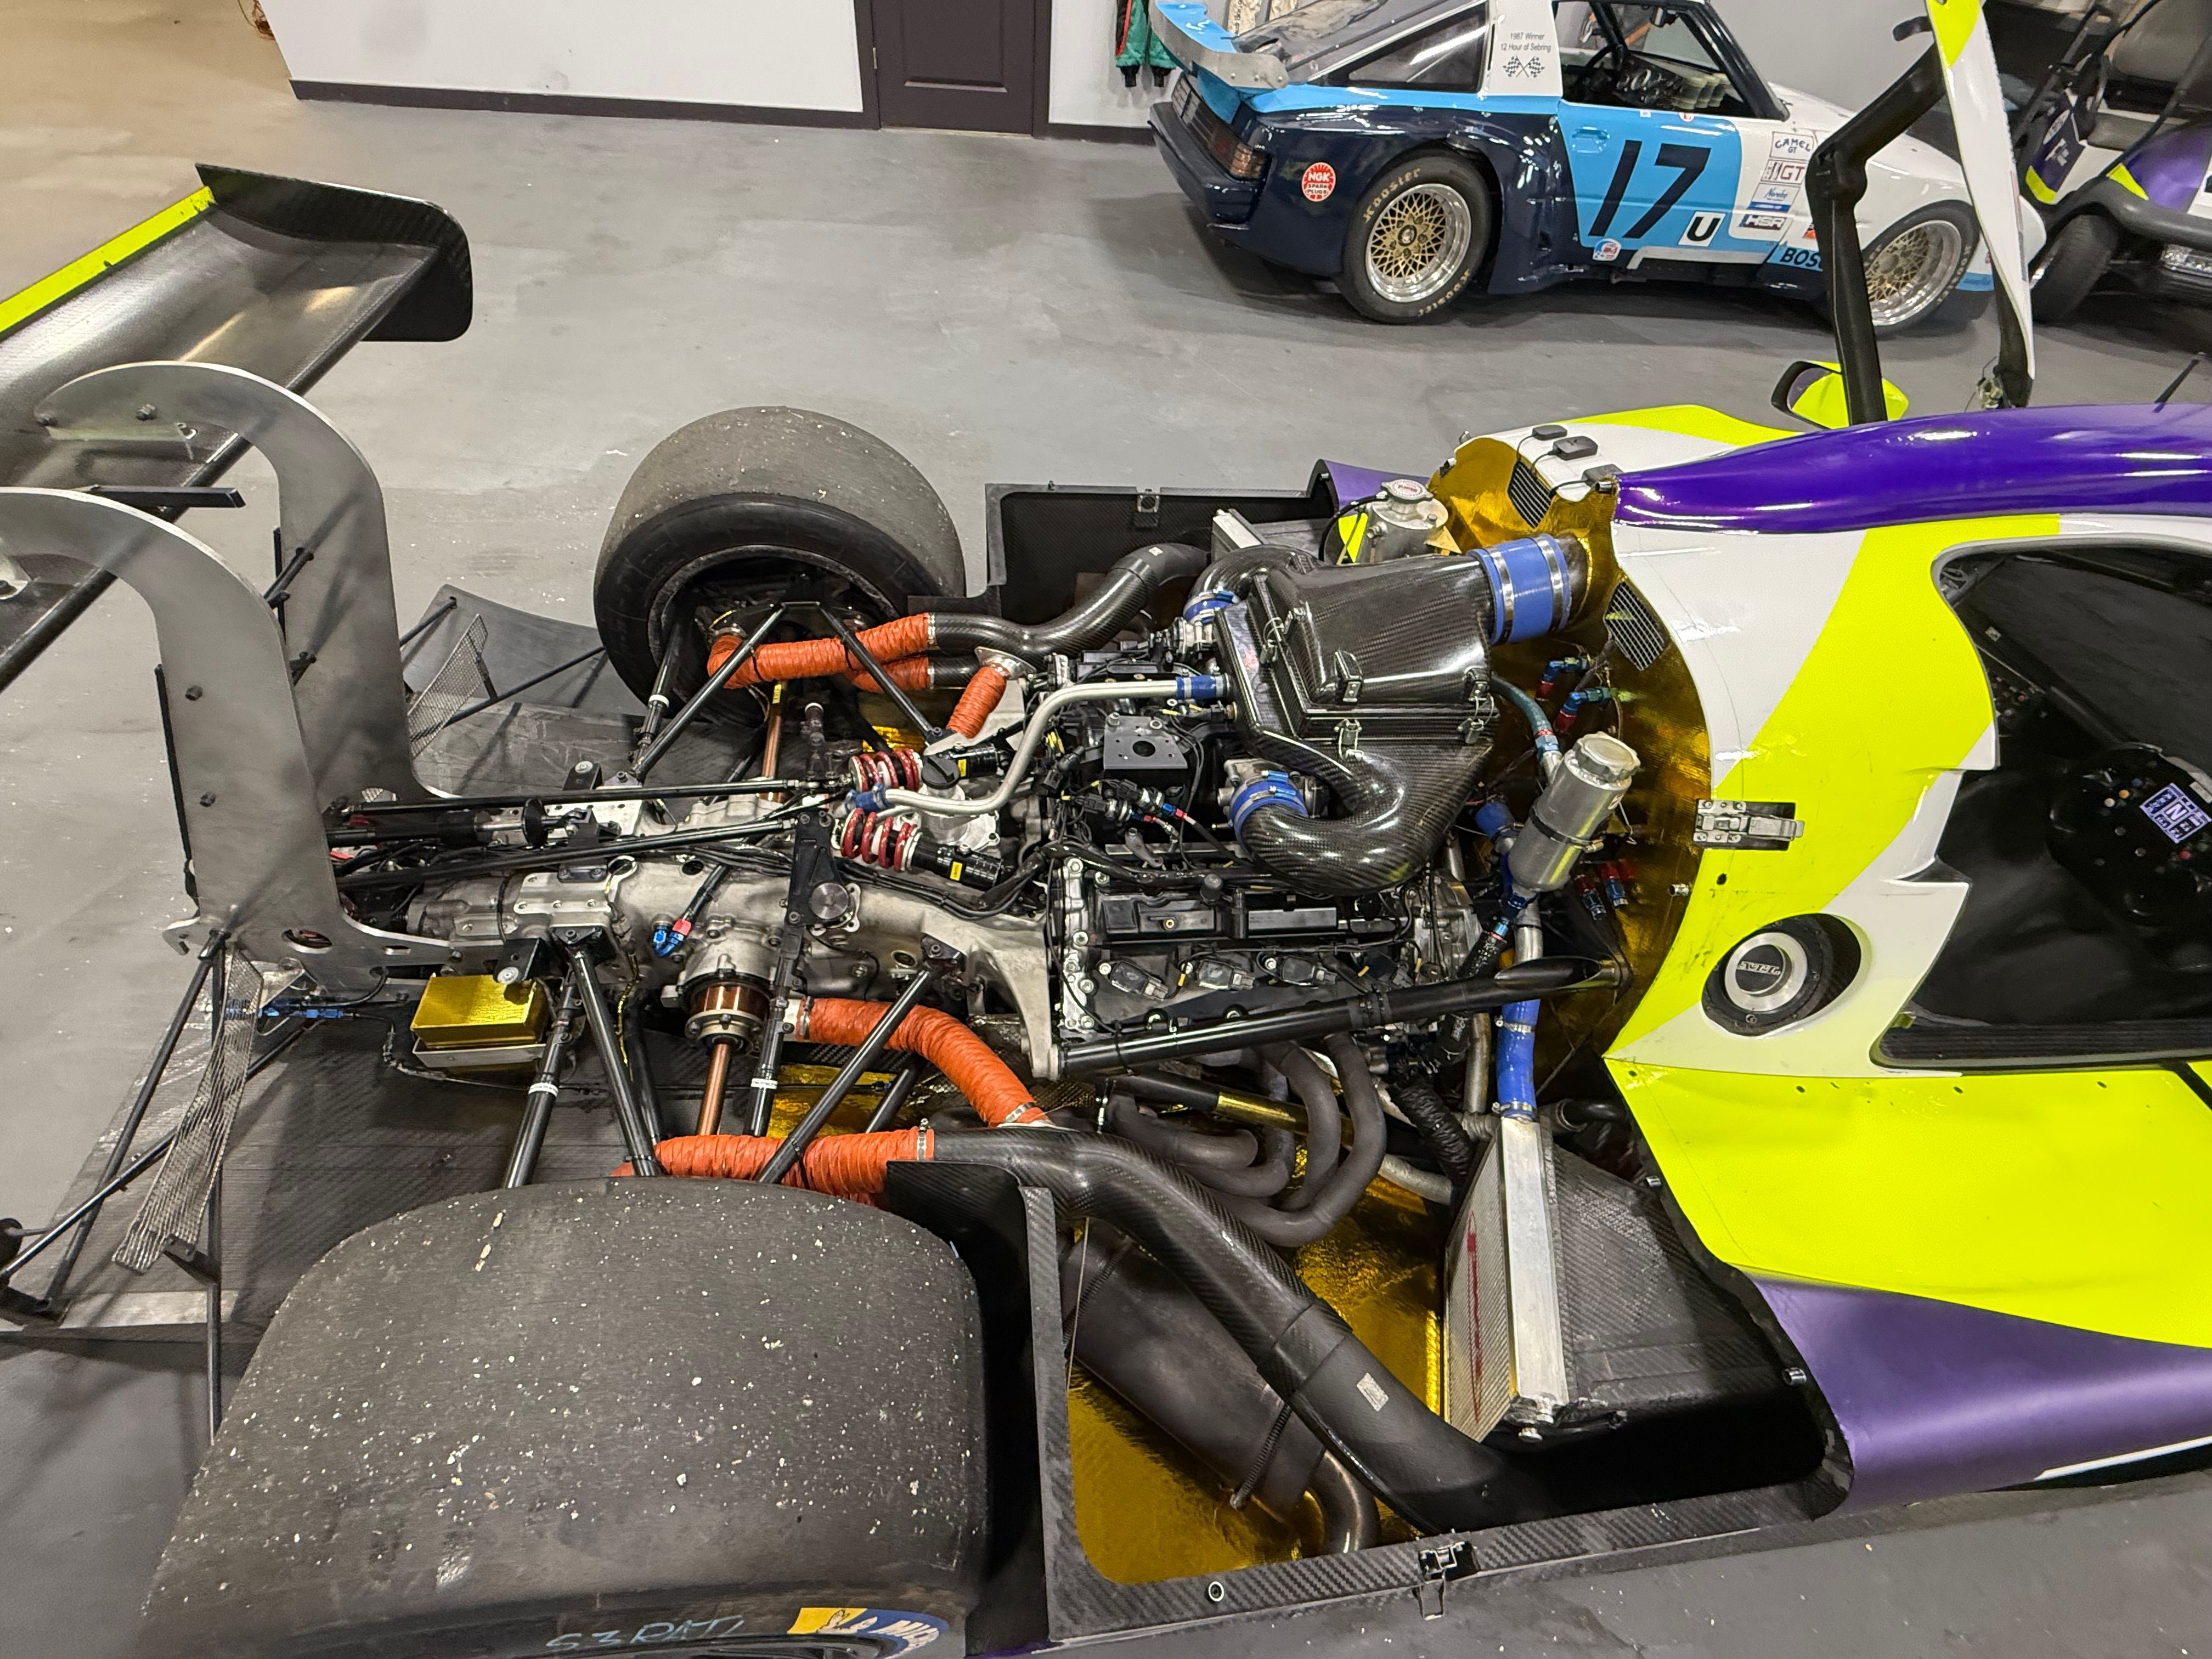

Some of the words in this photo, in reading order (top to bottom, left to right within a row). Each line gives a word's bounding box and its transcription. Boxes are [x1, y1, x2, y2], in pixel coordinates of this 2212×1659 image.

[1500, 43, 1508, 51] 12
[1530, 43, 1551, 53] Sebring
[1775, 138, 1811, 152] CAMEL
[1307, 172, 1331, 183] NGK
[1780, 165, 1805, 181] GT
[1588, 139, 1712, 239] 17
[1745, 215, 1785, 228] HSR
[1686, 216, 1721, 242] U
